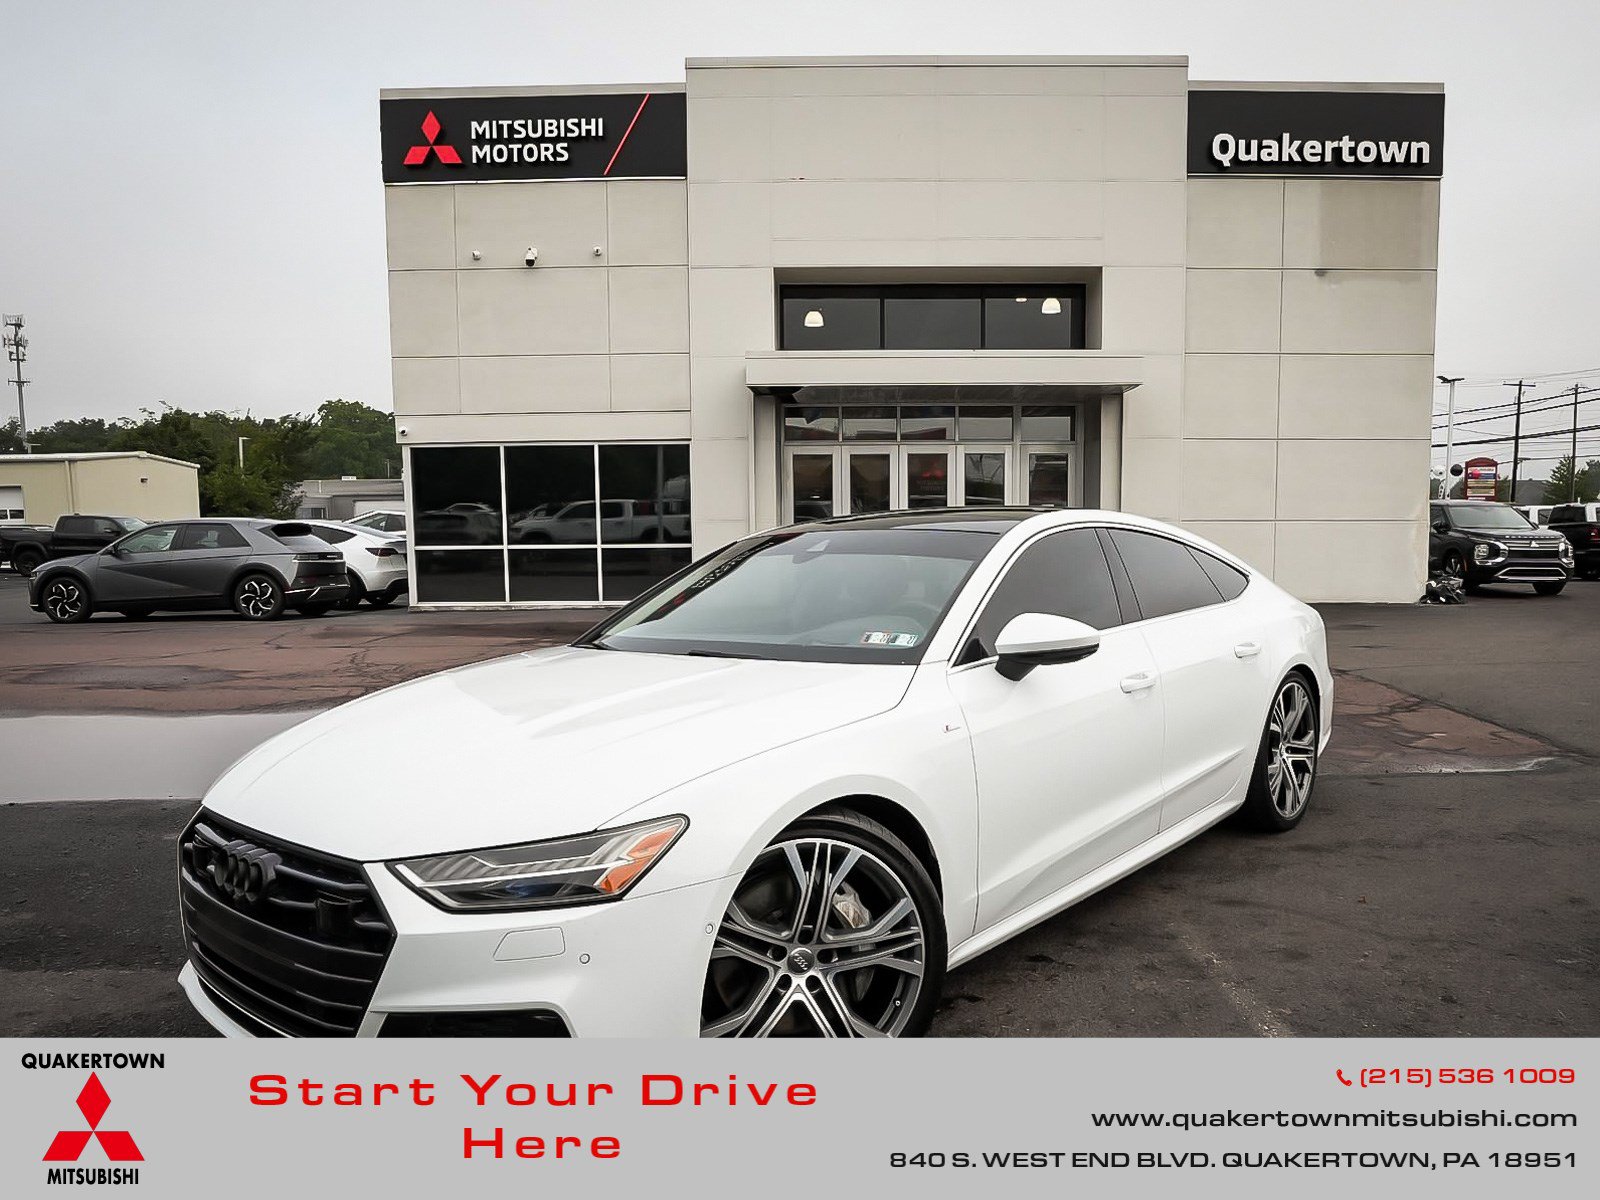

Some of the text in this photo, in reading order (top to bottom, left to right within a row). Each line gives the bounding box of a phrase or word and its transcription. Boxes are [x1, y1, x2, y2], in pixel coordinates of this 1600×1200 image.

[470, 117, 604, 140] MITSUBISHI
[471, 142, 569, 164] MOTORS
[1211, 132, 1431, 167] Quakertown
